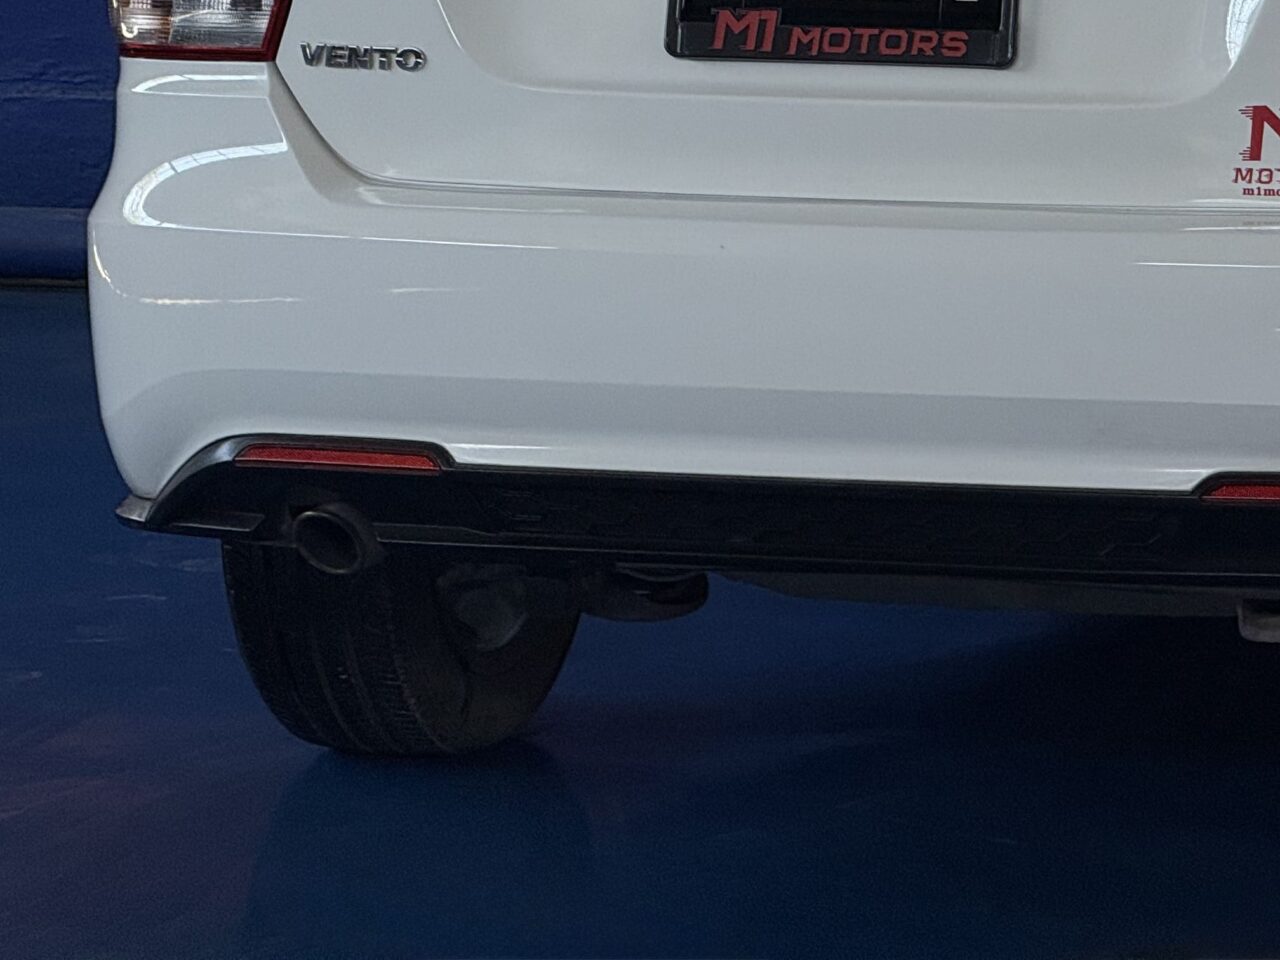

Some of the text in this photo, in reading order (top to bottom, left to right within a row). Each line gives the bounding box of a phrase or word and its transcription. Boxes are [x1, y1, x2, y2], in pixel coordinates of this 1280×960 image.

[709, 7, 969, 58] M1 MOTORS
[300, 42, 428, 73] VENTO
